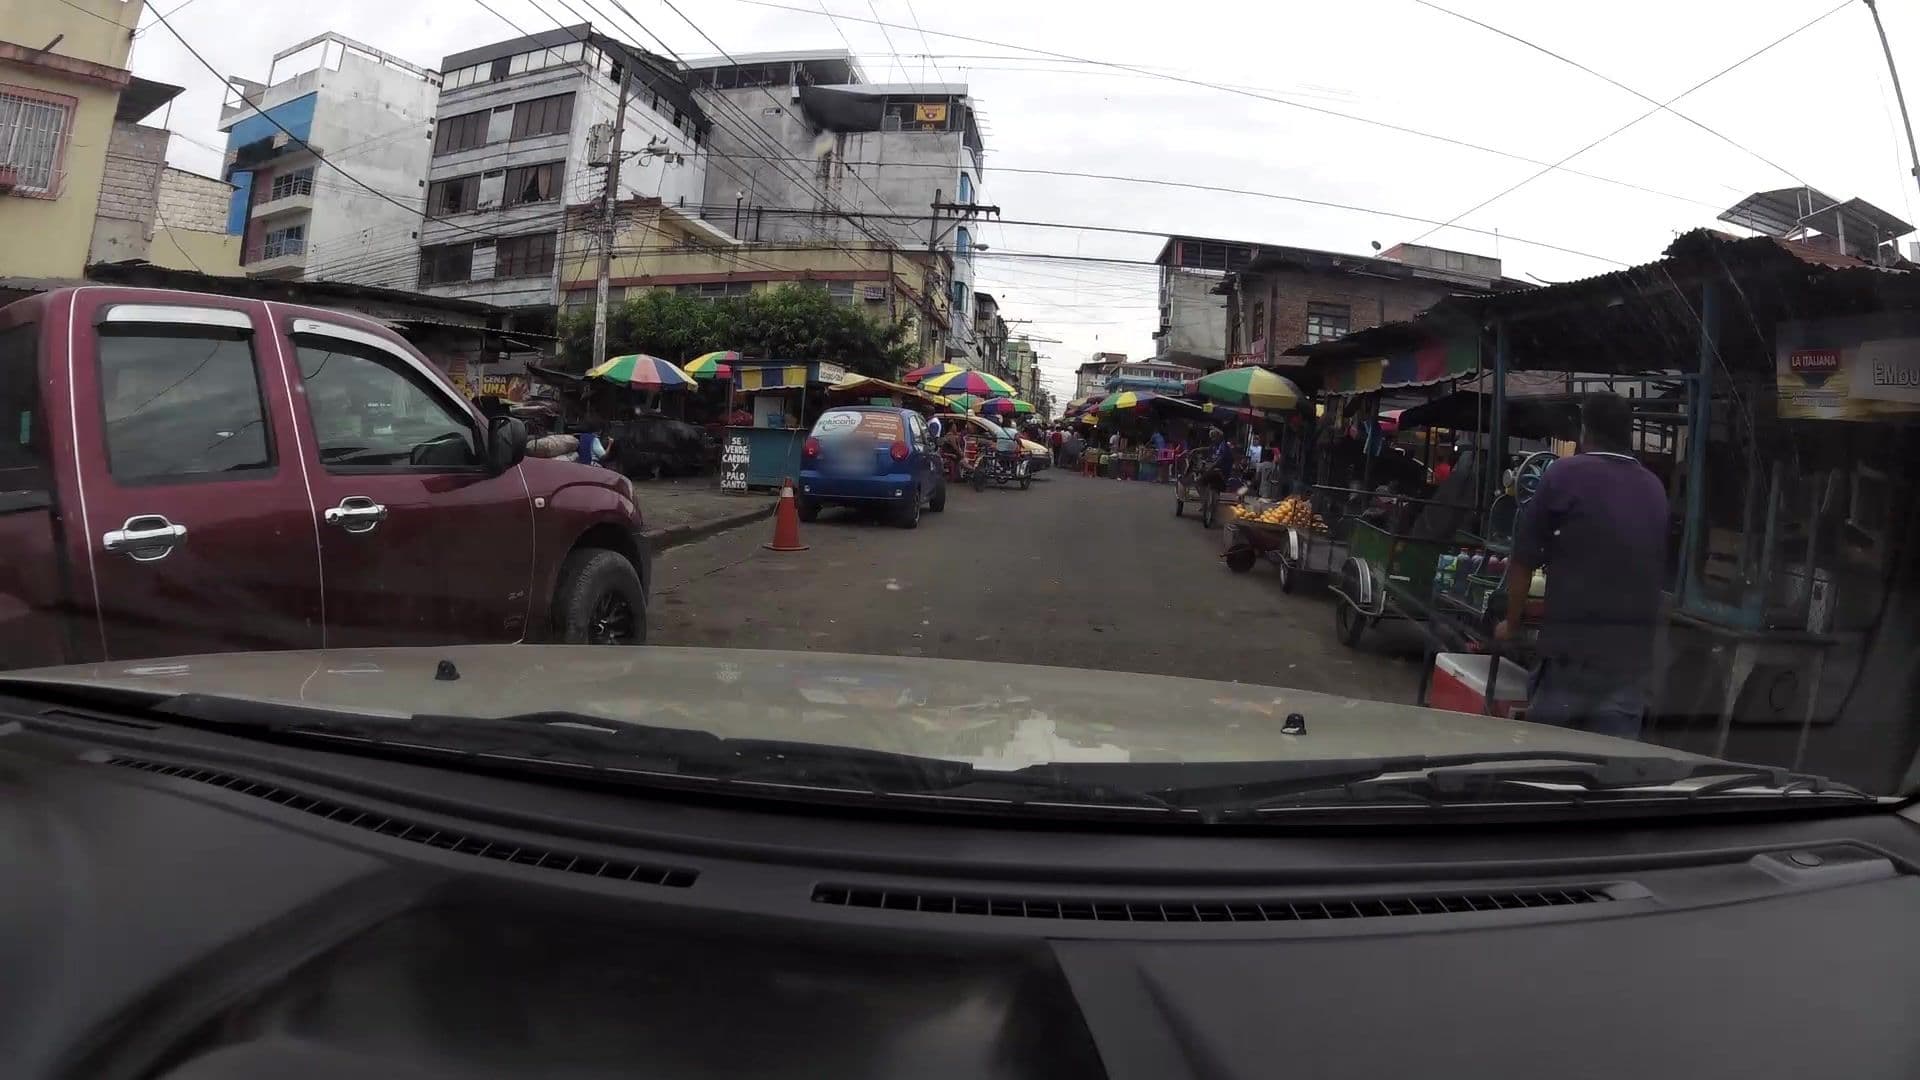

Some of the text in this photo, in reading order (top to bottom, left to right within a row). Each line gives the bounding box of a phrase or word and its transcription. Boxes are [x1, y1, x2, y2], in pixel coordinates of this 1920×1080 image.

[1791, 355, 1836, 367] LA ITALIANA
[483, 375, 506, 384] CENA
[731, 437, 742, 445] SE
[725, 445, 748, 454] VENDE
[722, 454, 750, 463] CARBON
[731, 463, 740, 471] Y
[726, 472, 745, 480] PALO
[720, 480, 747, 488] SANTO
